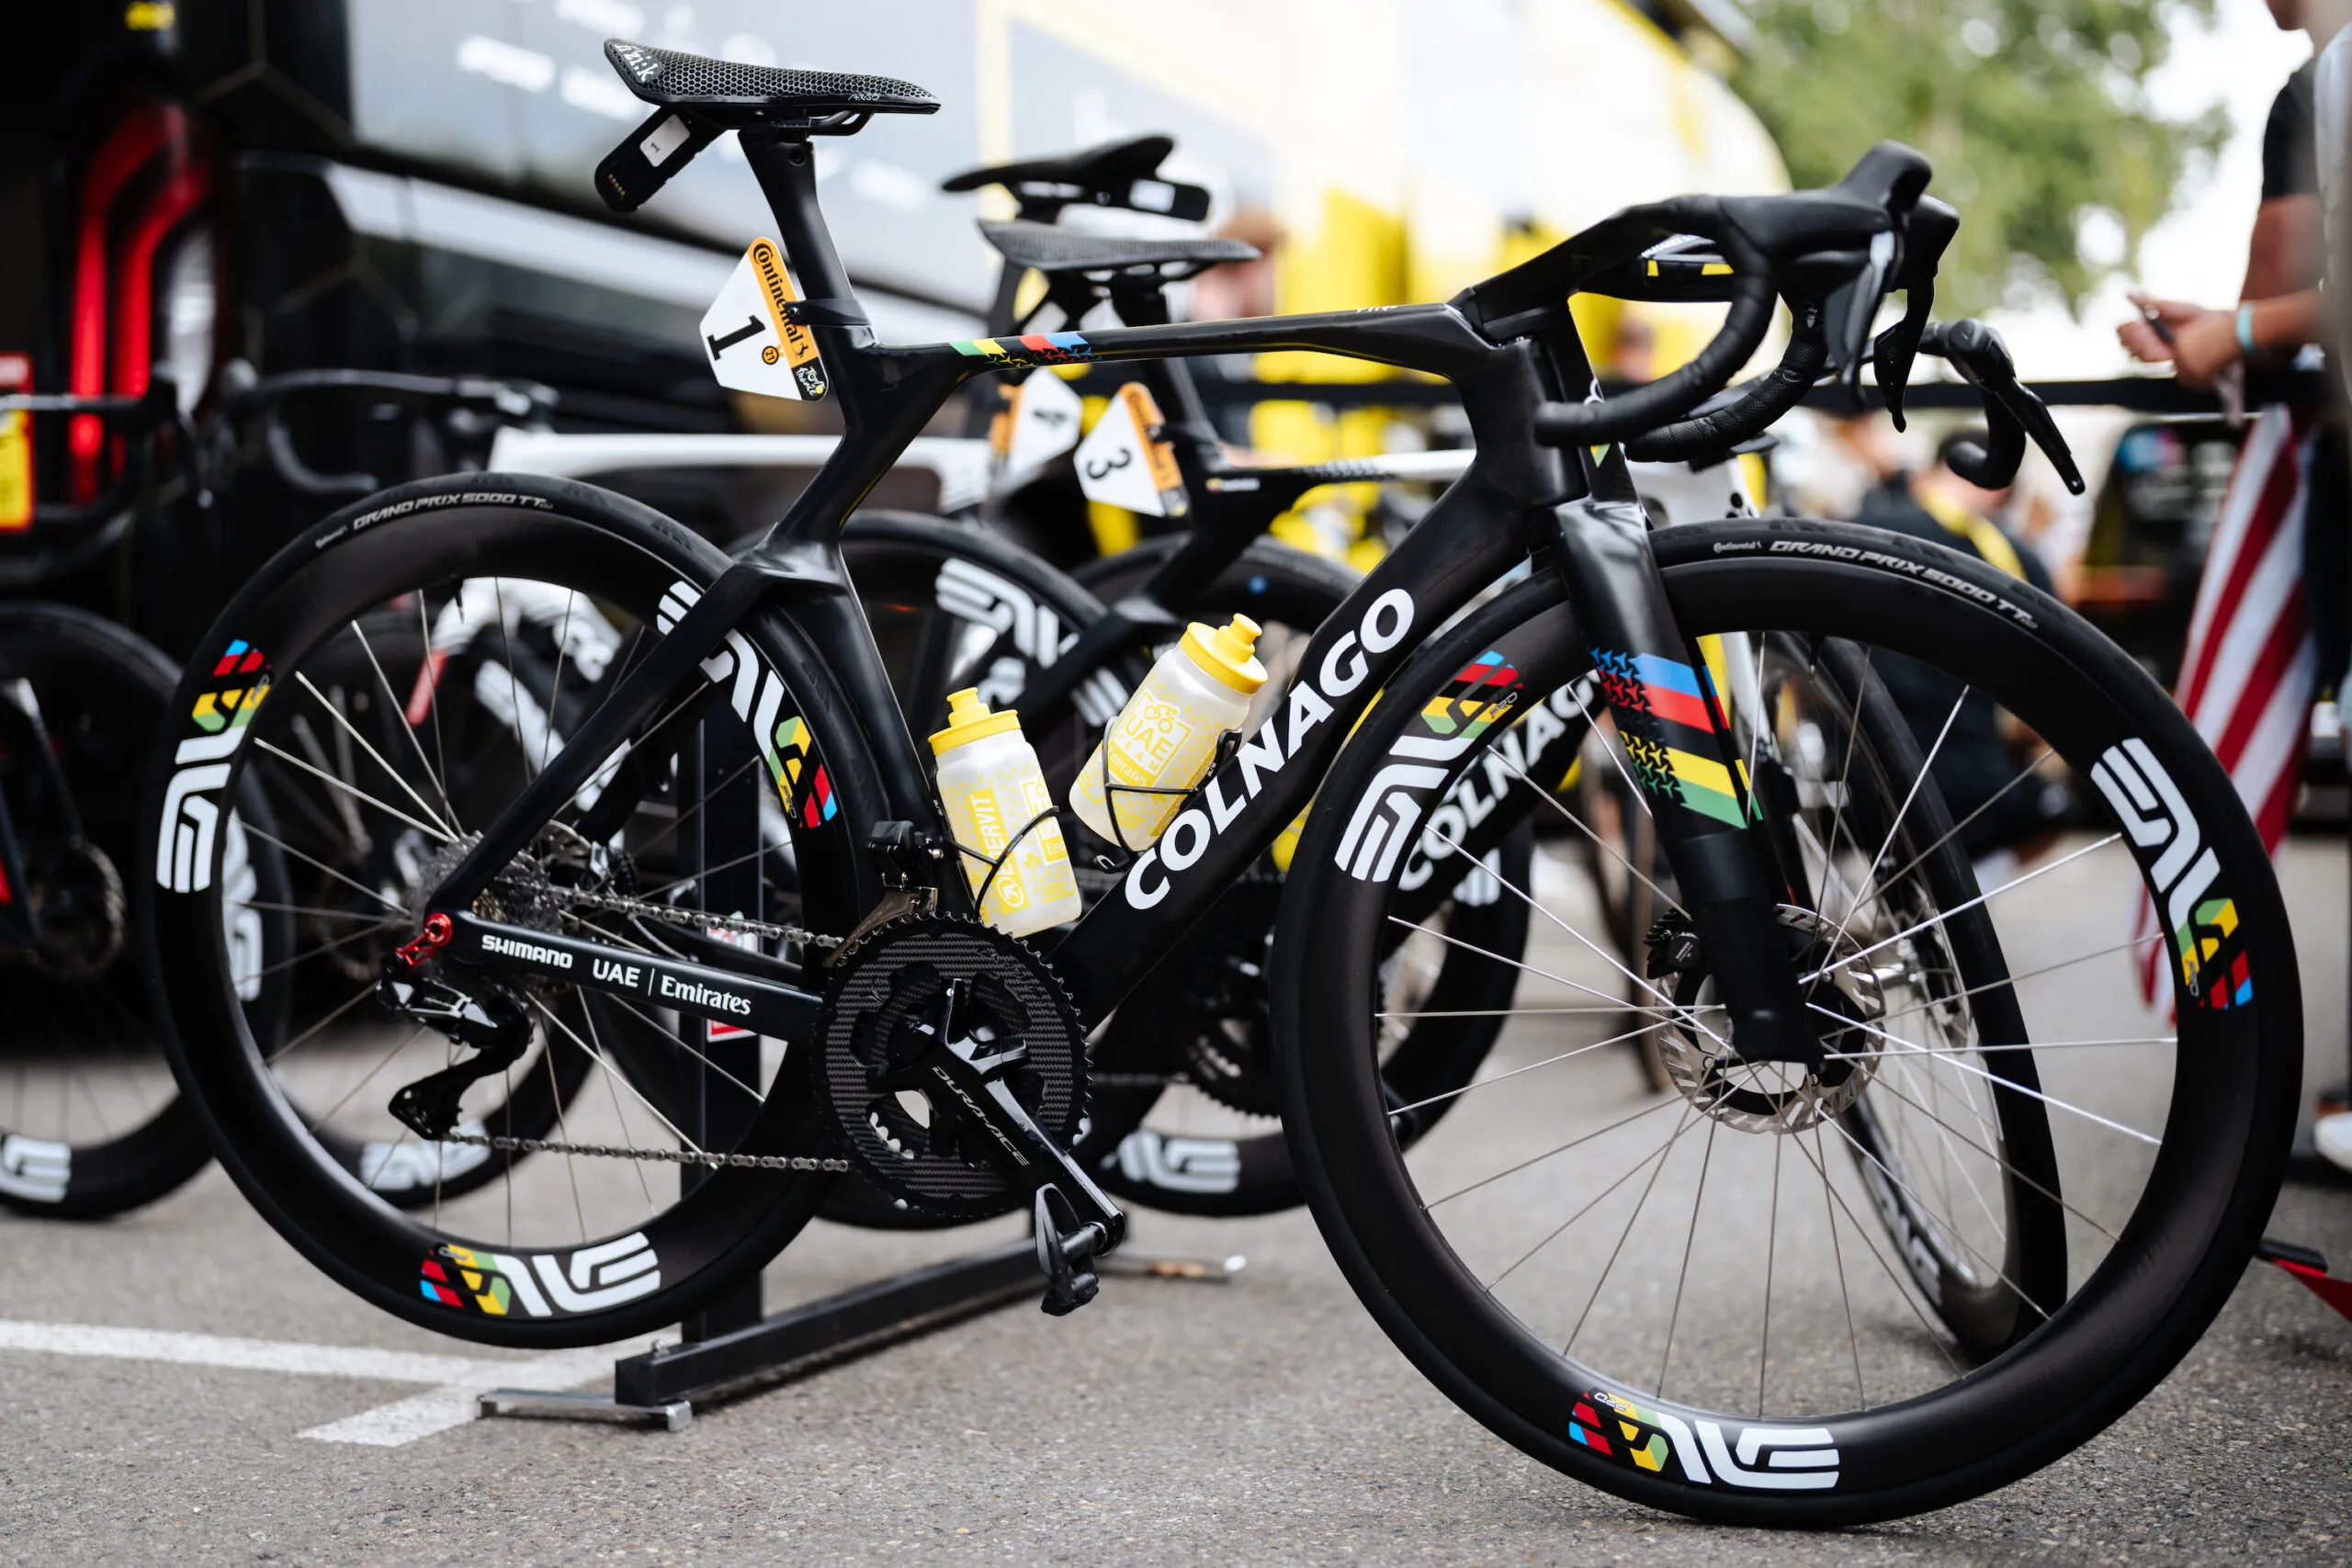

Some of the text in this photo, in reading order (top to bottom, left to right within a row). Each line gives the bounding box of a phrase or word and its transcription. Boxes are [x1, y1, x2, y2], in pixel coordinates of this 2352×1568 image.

[650, 141, 661, 153] 1
[707, 314, 766, 361] 1
[1085, 447, 1133, 480] 3
[353, 501, 414, 531] GRAND
[413, 492, 461, 510] PRIX
[460, 492, 517, 504] 5000
[1770, 539, 1861, 559] GRAND
[1858, 550, 1926, 575] PRIX
[1921, 568, 1998, 604] 5000
[1125, 712, 1175, 761] UAE
[1125, 588, 1415, 910] COLNAGO
[481, 933, 752, 1016] SHIMANO UAE Emirates
[932, 1066, 1030, 1167] DURA-ACE
